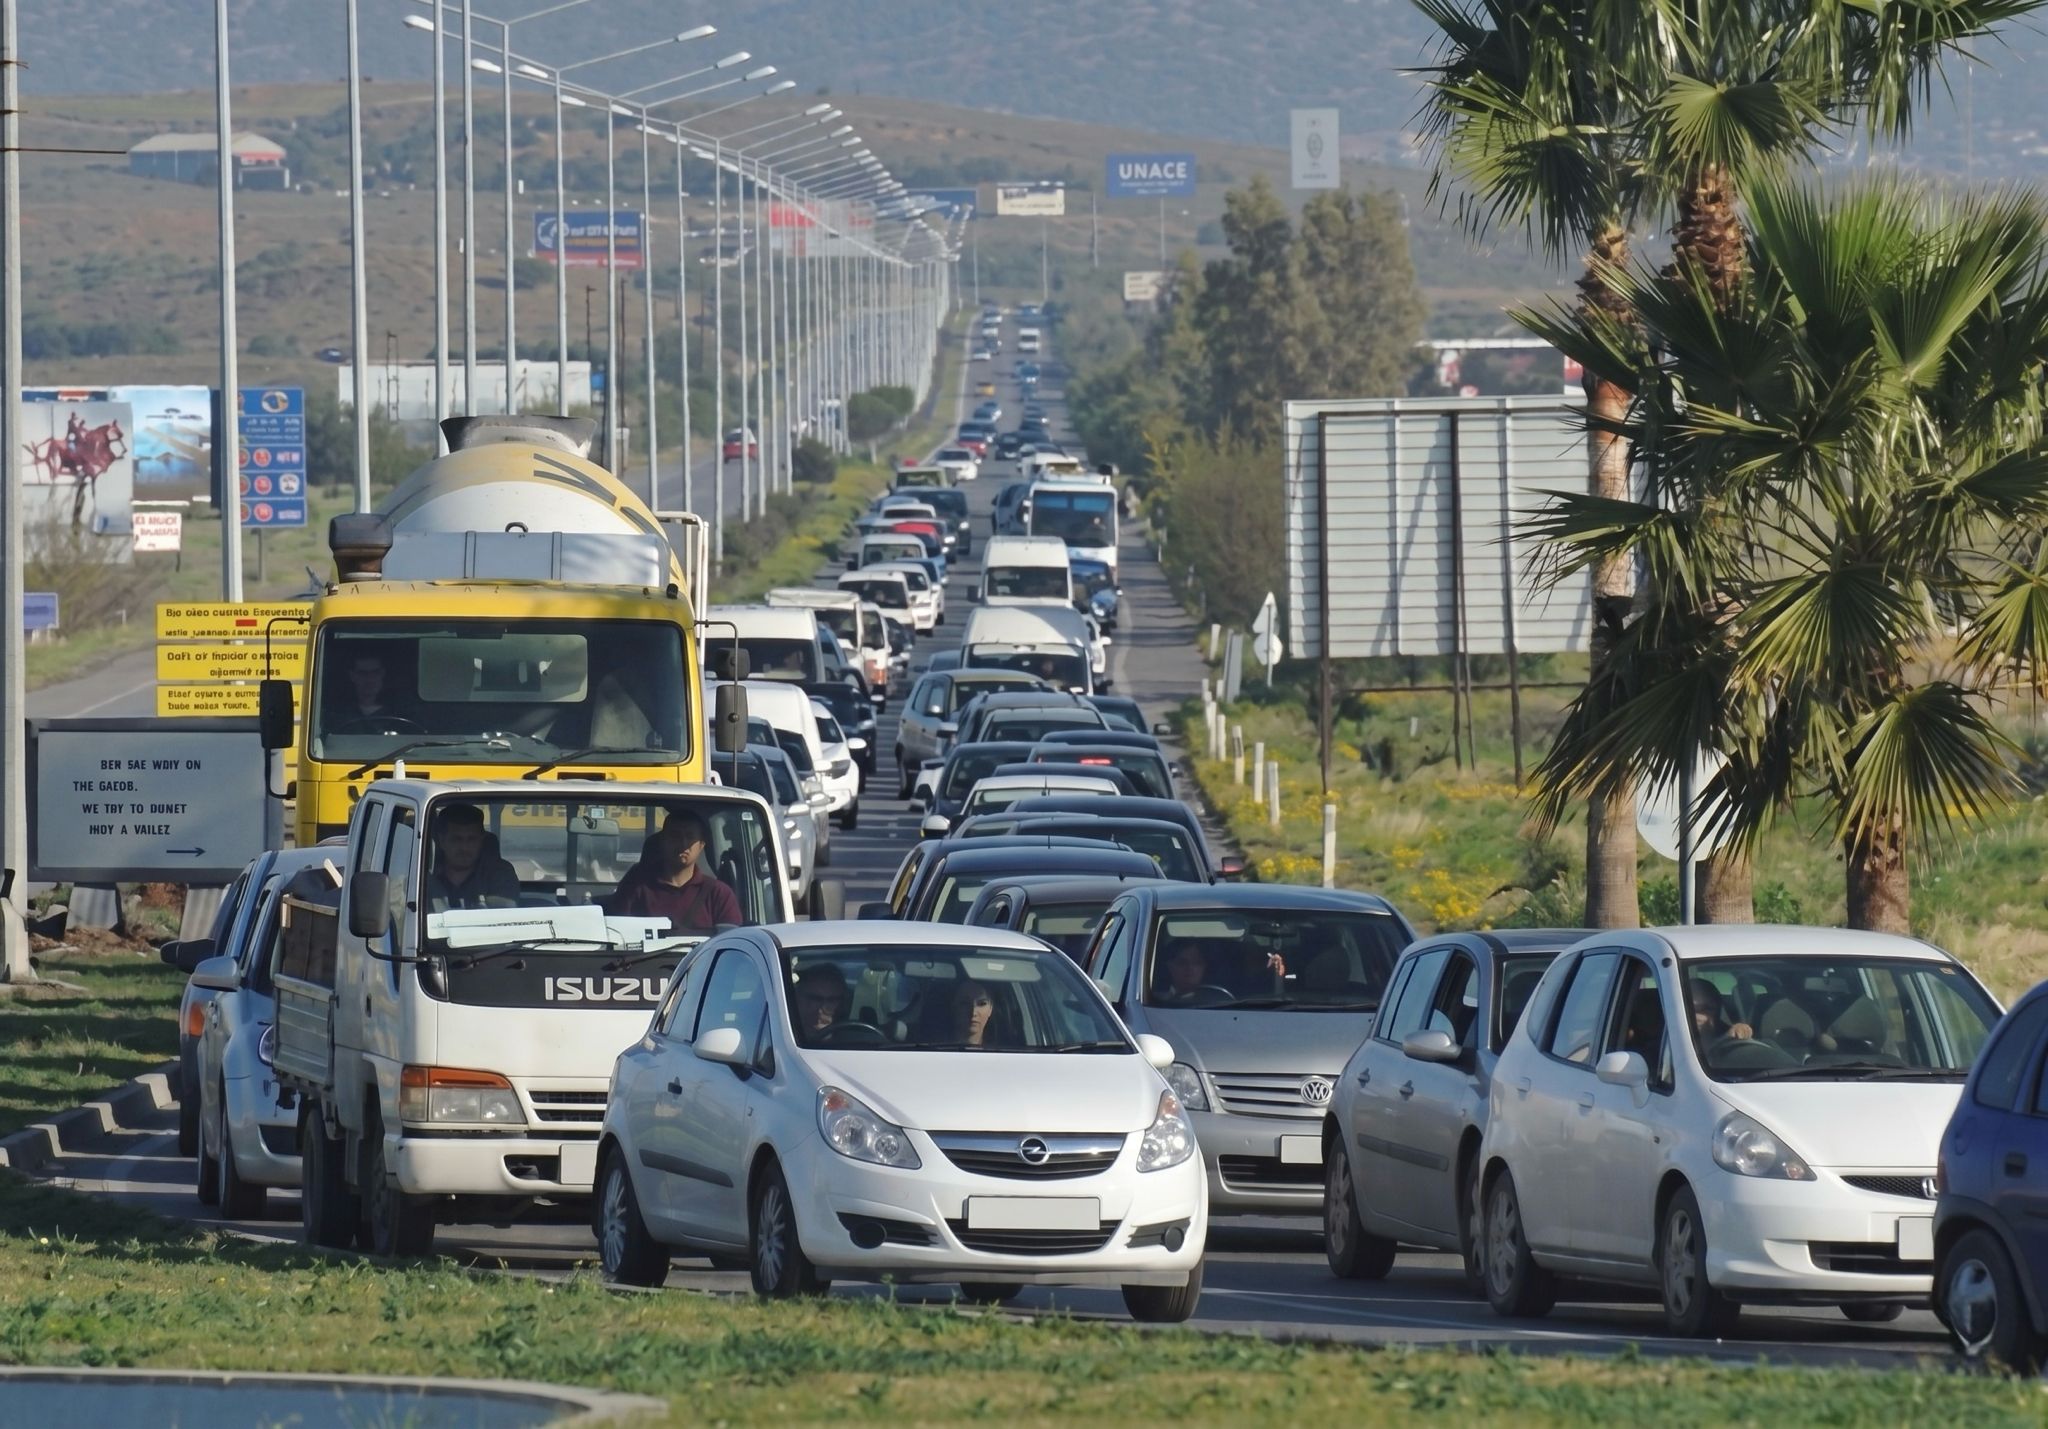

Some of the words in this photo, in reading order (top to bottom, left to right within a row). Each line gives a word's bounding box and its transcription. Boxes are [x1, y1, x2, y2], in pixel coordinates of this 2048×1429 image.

[1119, 161, 1187, 180] UNACE
[185, 760, 201, 770] ON
[73, 781, 94, 792] THE
[82, 803, 99, 814] WE
[130, 803, 144, 814] TO
[120, 824, 128, 835] A
[545, 977, 669, 1001] ISUZU
